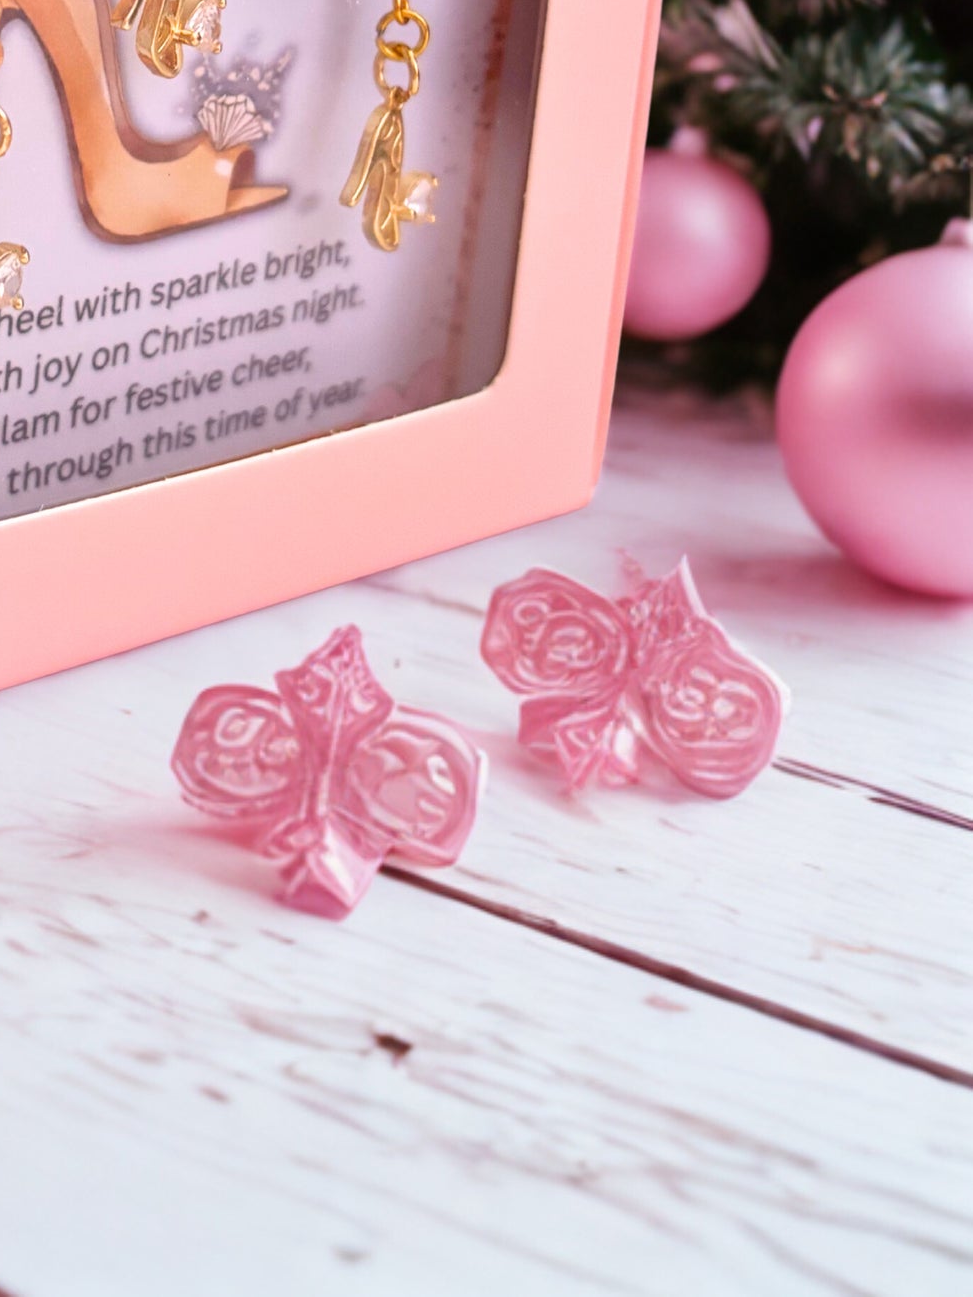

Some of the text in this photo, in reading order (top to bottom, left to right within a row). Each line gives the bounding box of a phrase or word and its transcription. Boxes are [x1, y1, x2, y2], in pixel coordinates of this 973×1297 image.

[75, 282, 141, 322] with
[150, 258, 257, 309] sparkle
[264, 239, 352, 280] bright,
[28, 353, 83, 395] joy
[92, 341, 130, 371] on
[140, 303, 285, 359] Christmas
[70, 396, 117, 429] for
[124, 370, 223, 415] festive
[231, 347, 312, 386] cheer,
[7, 437, 133, 496] through
[143, 421, 197, 459] this
[205, 409, 267, 442] time
[274, 386, 305, 422] of
